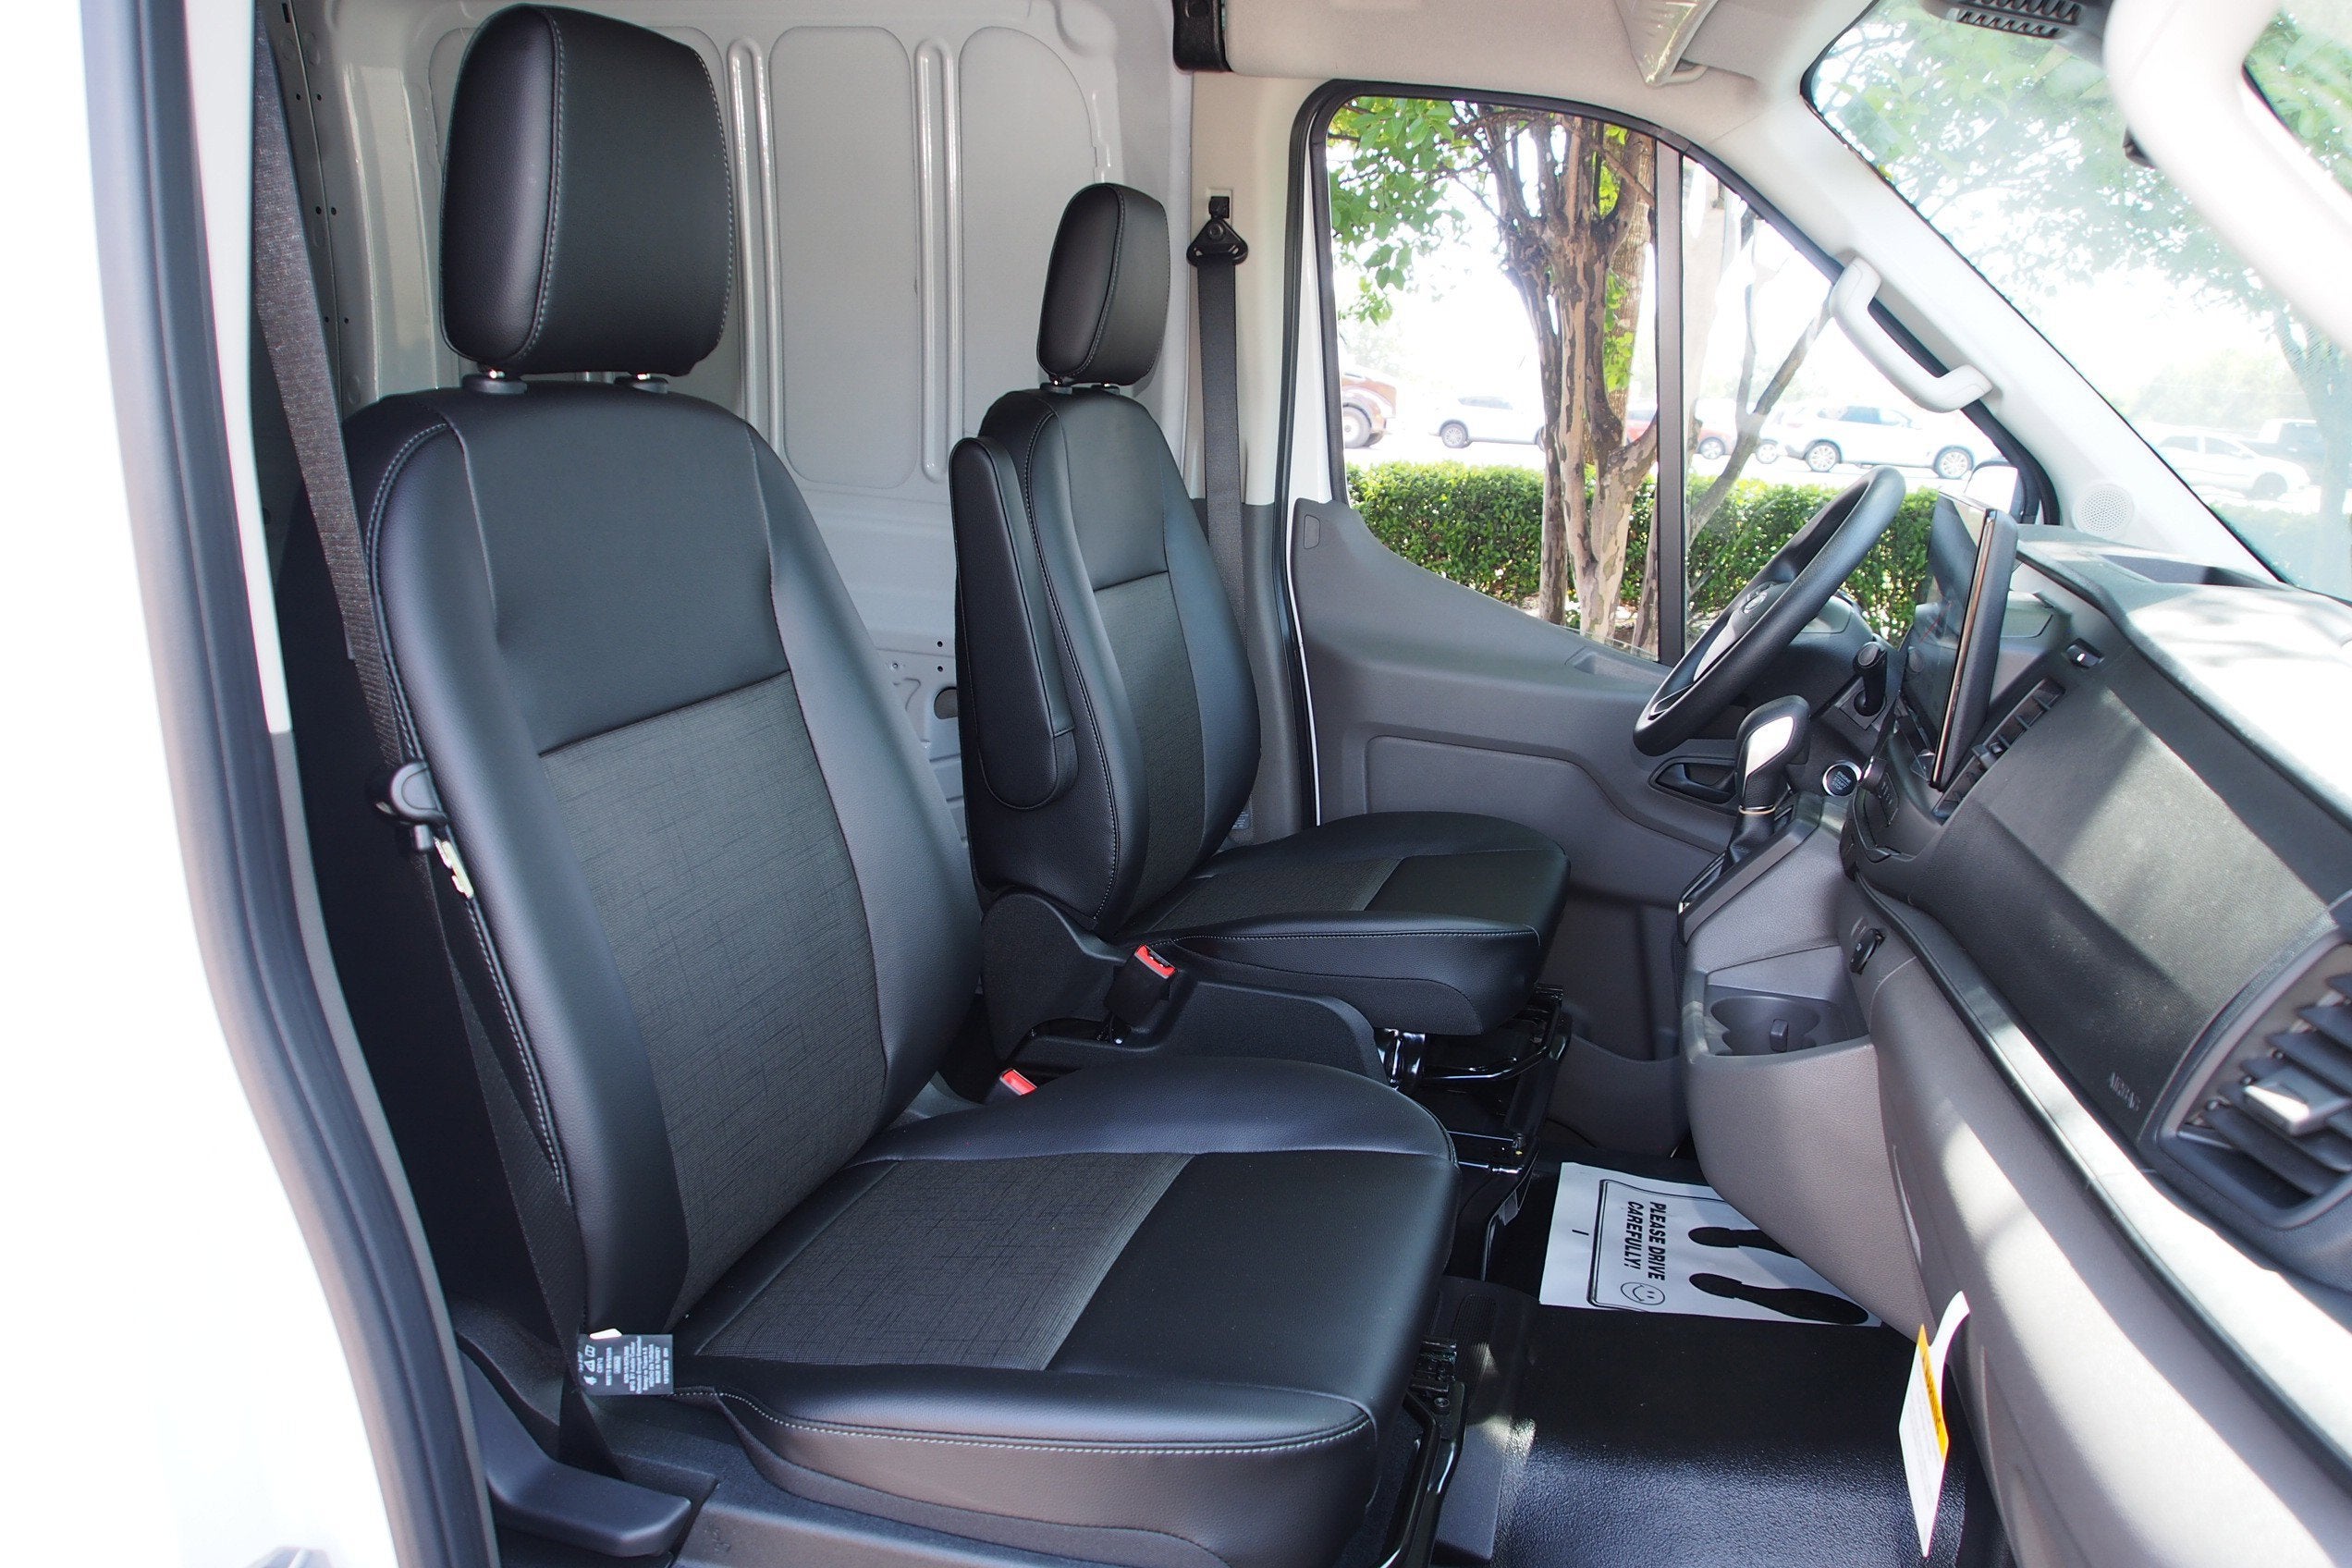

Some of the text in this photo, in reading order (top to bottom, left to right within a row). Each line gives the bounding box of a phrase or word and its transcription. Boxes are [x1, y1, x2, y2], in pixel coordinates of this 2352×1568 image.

[1623, 1201, 1645, 1270] CAREFULLY!
[1648, 1201, 1667, 1281] PLEASE DRIVE
